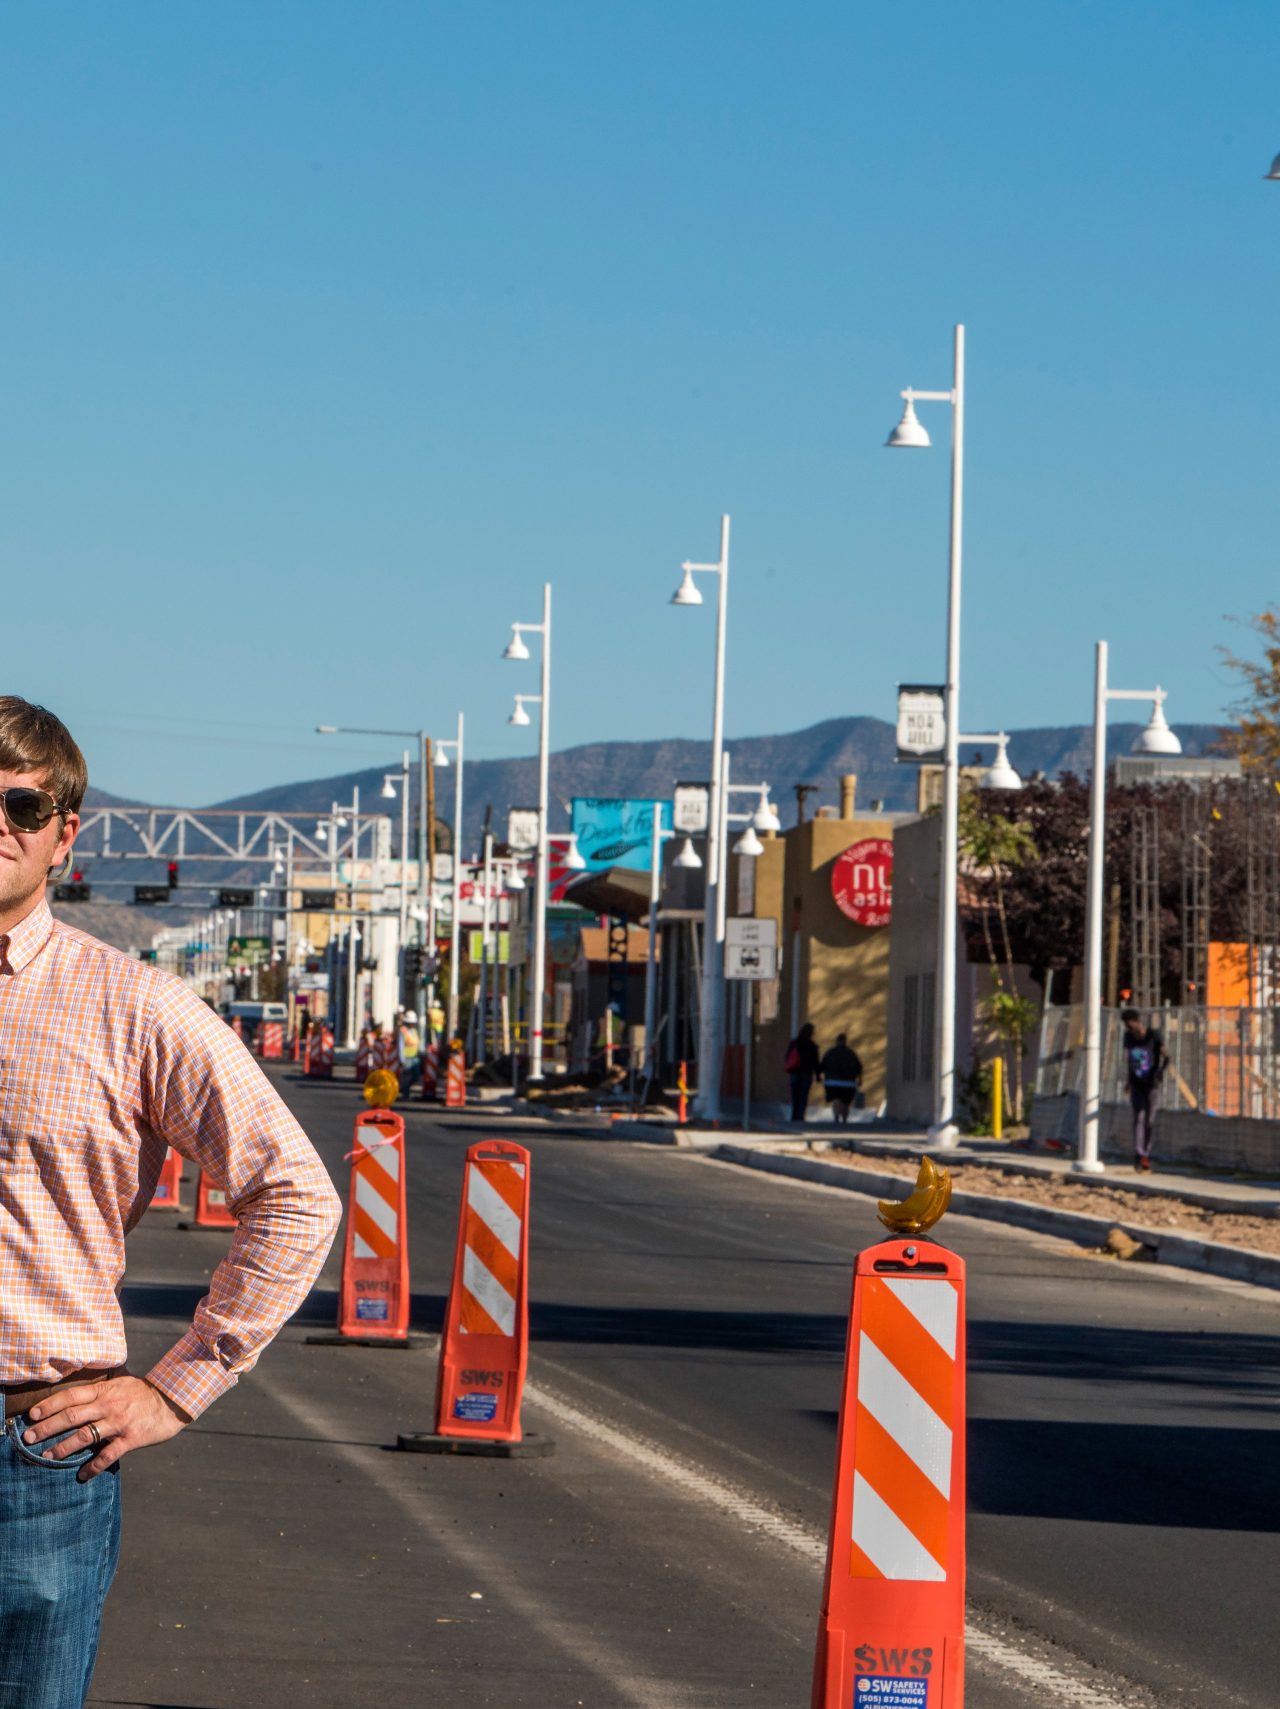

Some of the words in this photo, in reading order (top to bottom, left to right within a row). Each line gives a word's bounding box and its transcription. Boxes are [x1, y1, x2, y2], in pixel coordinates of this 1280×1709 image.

[460, 1369, 504, 1387] SWS
[854, 1645, 933, 1675] SWS
[871, 1679, 893, 1693] SW
[893, 1681, 925, 1689] SAFETY
[892, 1687, 926, 1695] SERVICES
[859, 1694, 881, 1703] (505)
